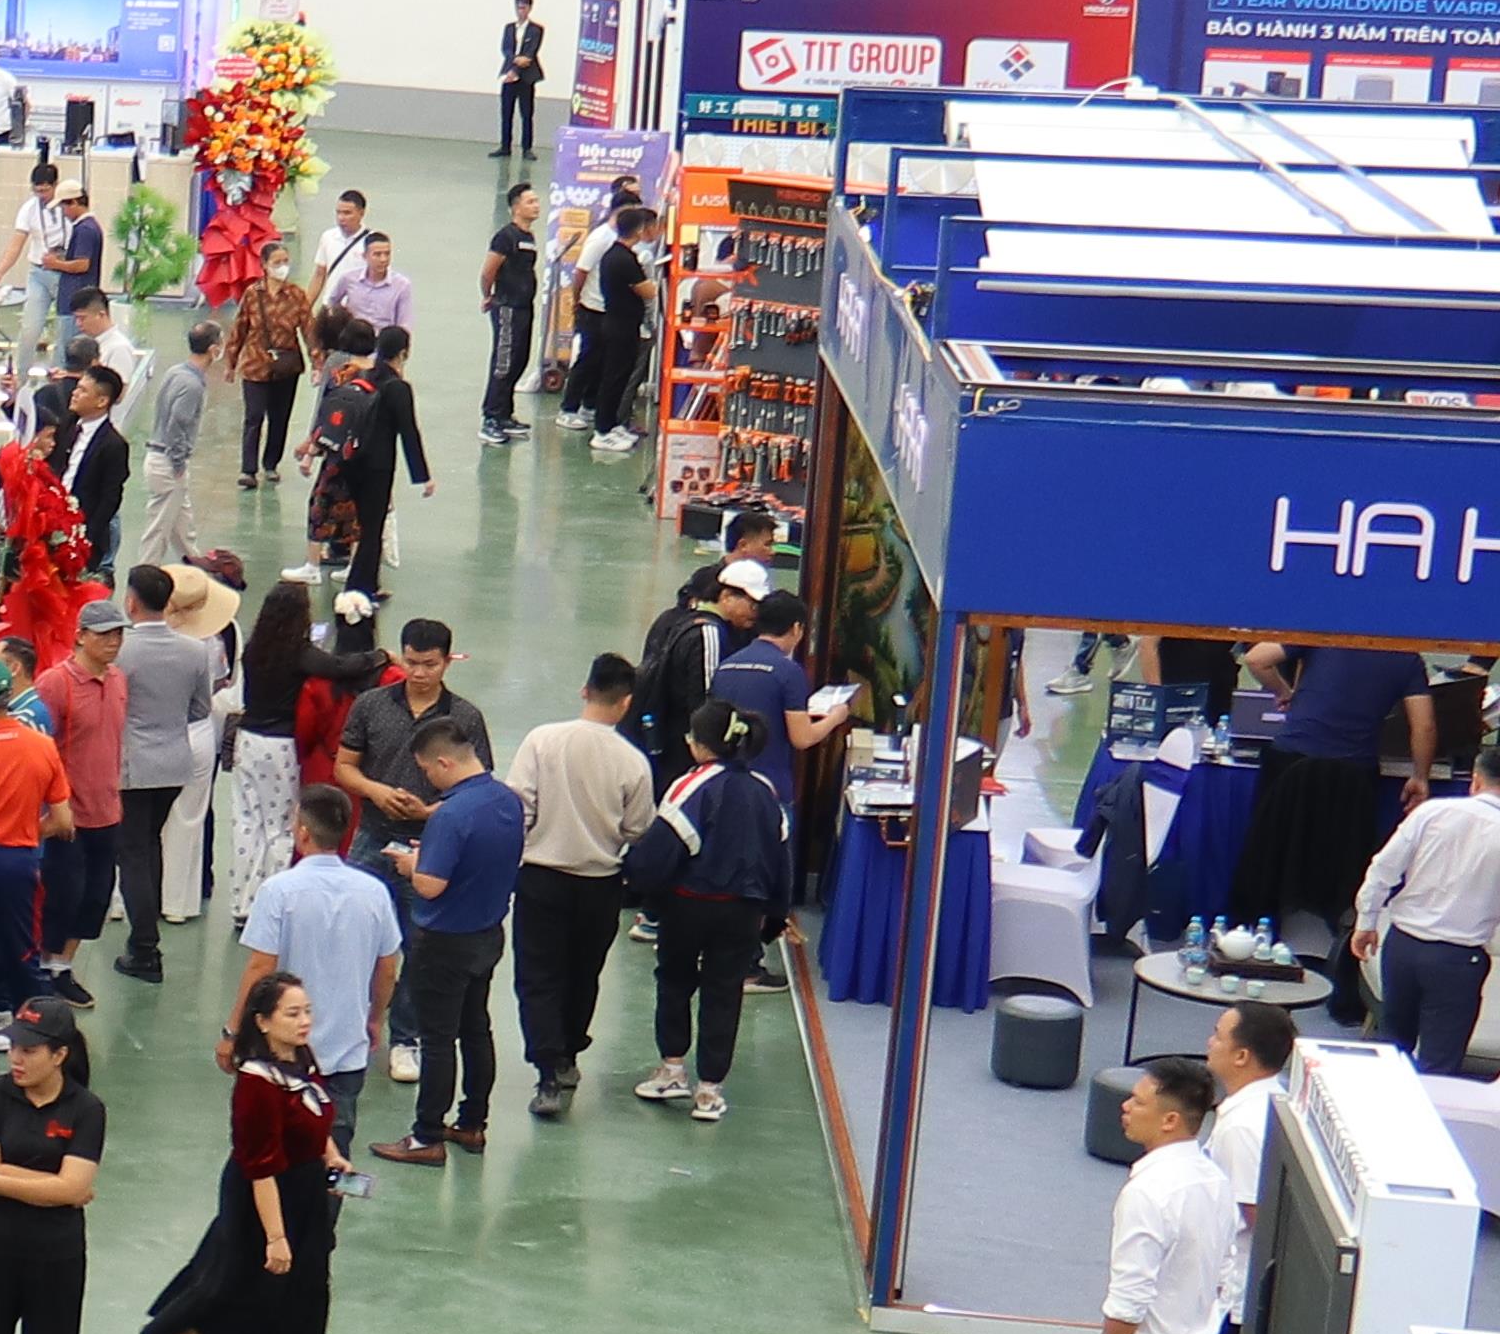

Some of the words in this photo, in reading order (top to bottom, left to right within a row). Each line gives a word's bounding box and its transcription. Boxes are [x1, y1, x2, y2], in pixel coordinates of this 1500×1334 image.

[1206, 17, 1251, 37] BẢO
[1256, 20, 1316, 40] HÀNH
[1320, 25, 1334, 41] 3
[1338, 22, 1386, 42] NĂM
[1391, 24, 1447, 45] TRÊN
[802, 40, 842, 74] TIT
[849, 42, 936, 77] GROUP
[1270, 496, 1435, 581] HA
